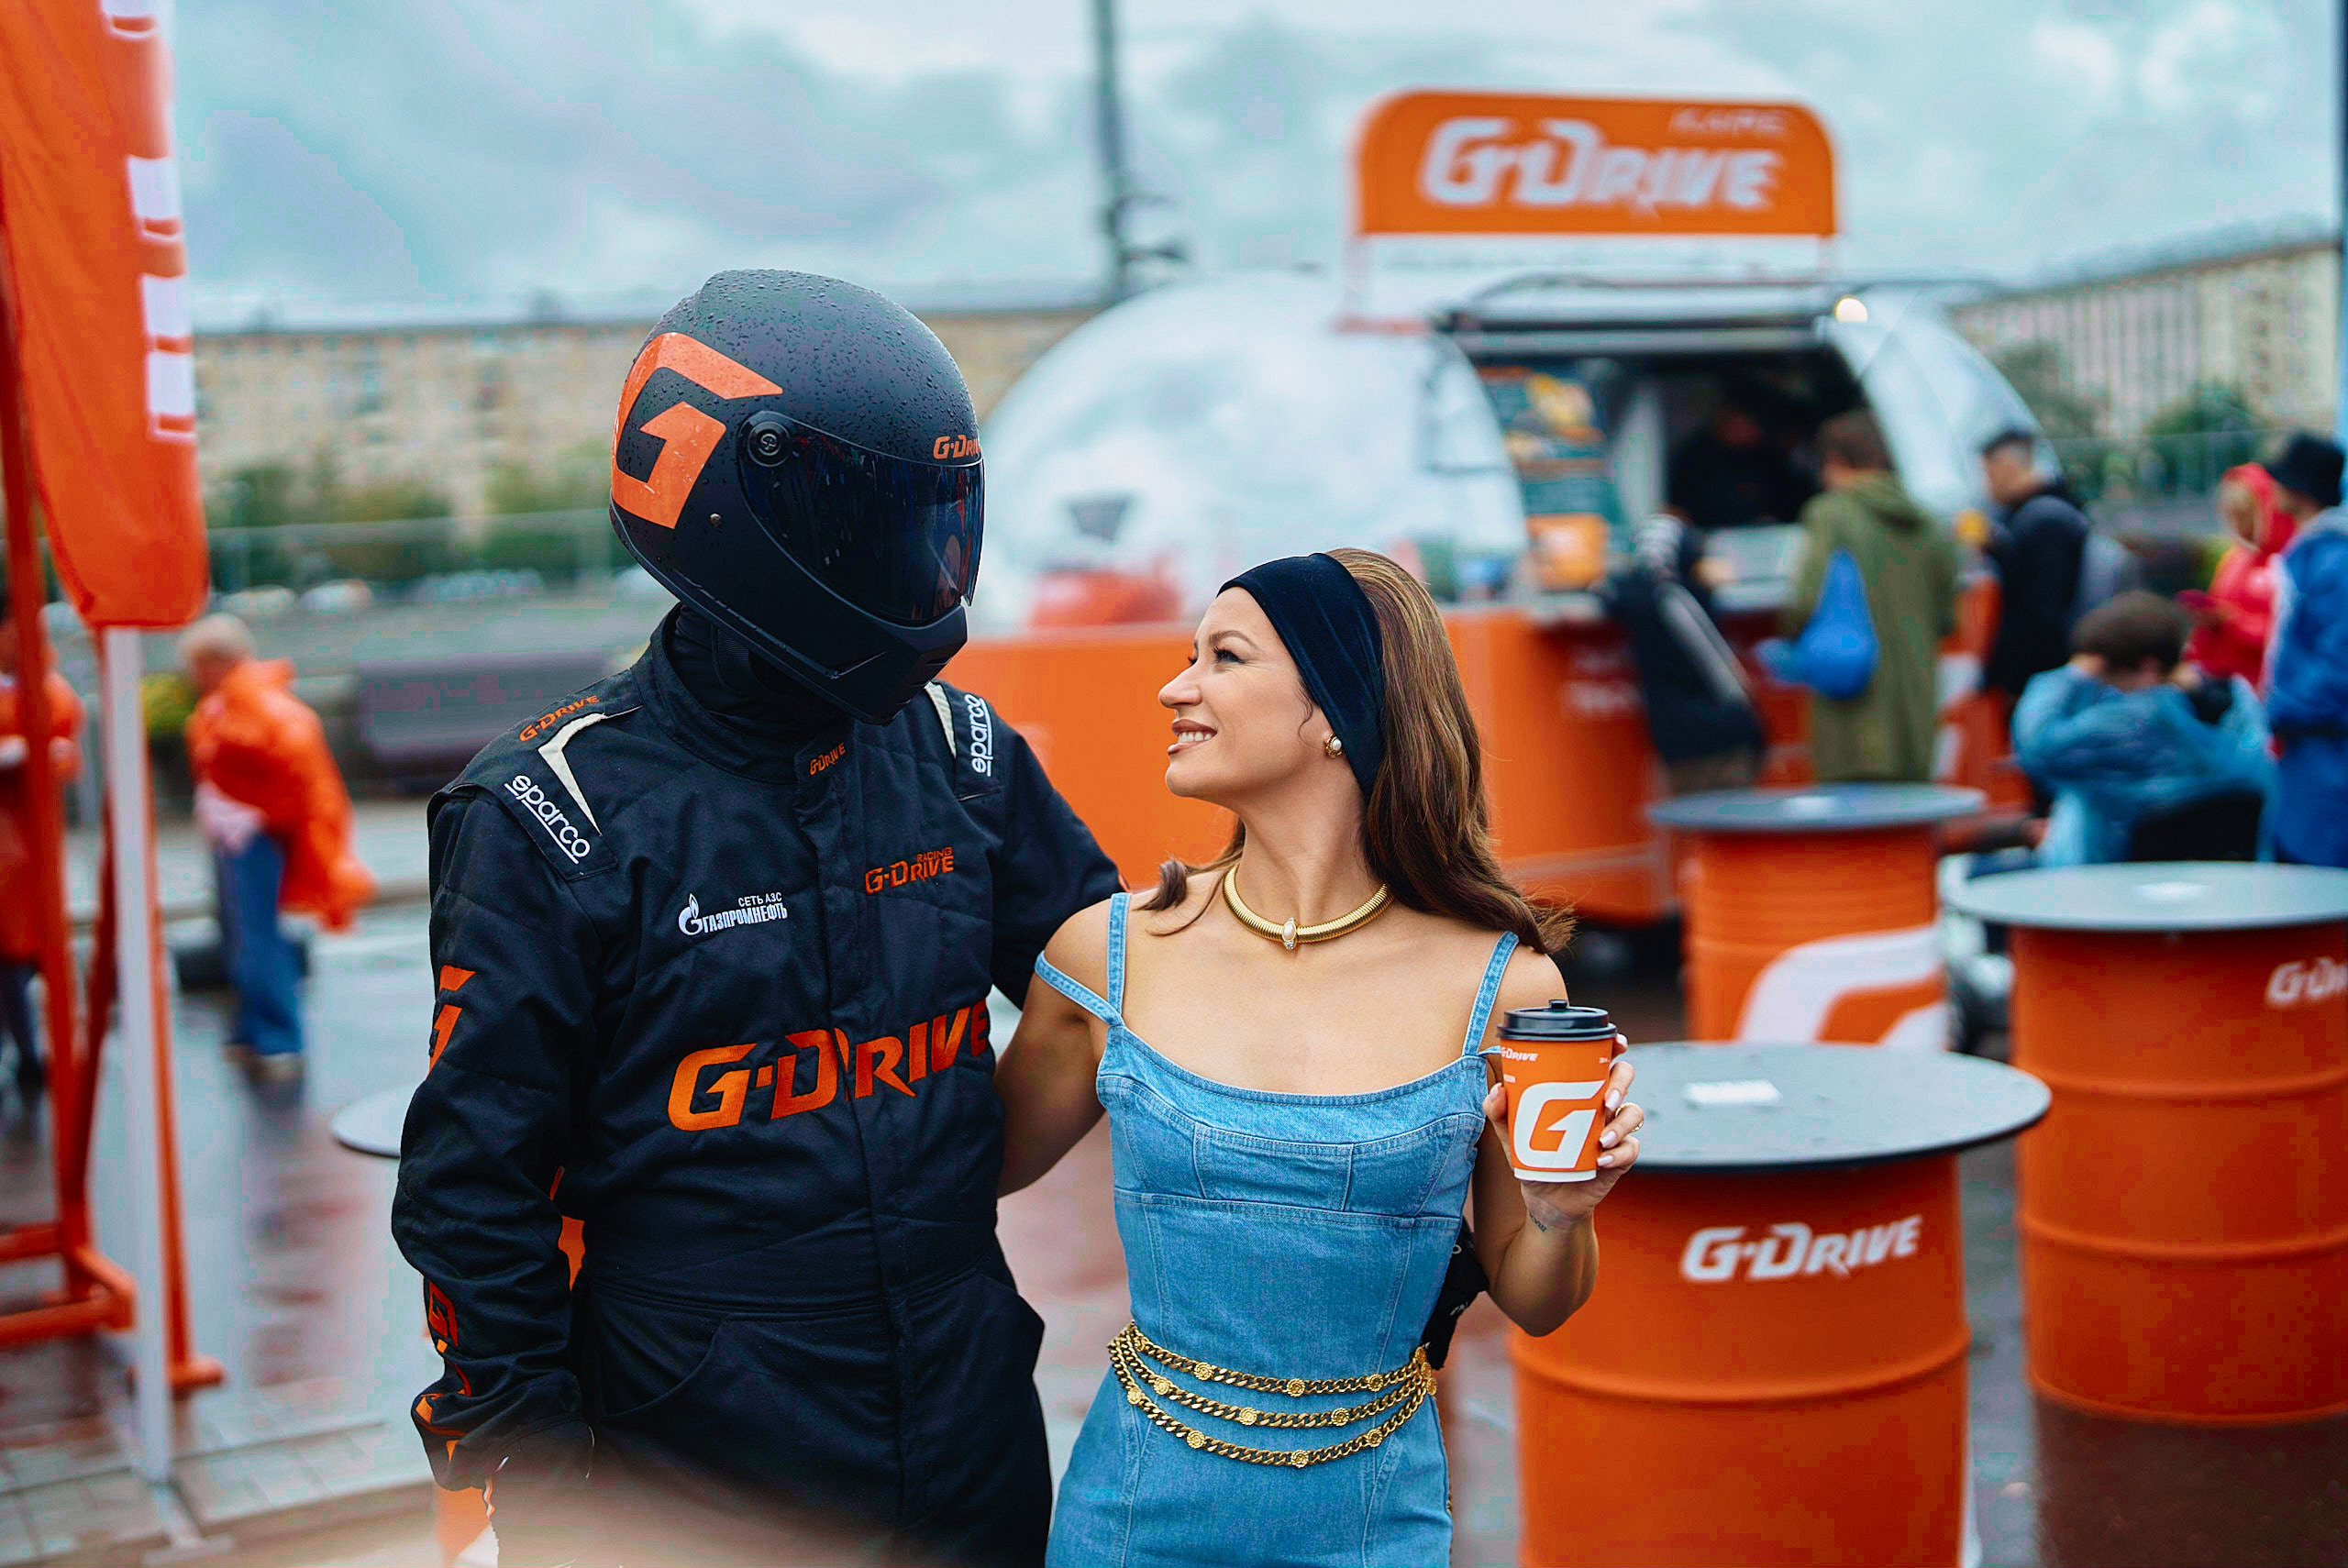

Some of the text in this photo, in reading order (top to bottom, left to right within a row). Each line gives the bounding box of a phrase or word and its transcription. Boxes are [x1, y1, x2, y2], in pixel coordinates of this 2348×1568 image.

[518, 695, 600, 742] G-DRIVE
[964, 693, 993, 777] sparco
[508, 775, 591, 861] sparco
[865, 856, 955, 895] G-DRIVE
[916, 846, 953, 863] RACING
[737, 891, 783, 908] СЕТЬ АЗС
[668, 998, 988, 1132] G-DRIVE
[1514, 1079, 1606, 1169] G
